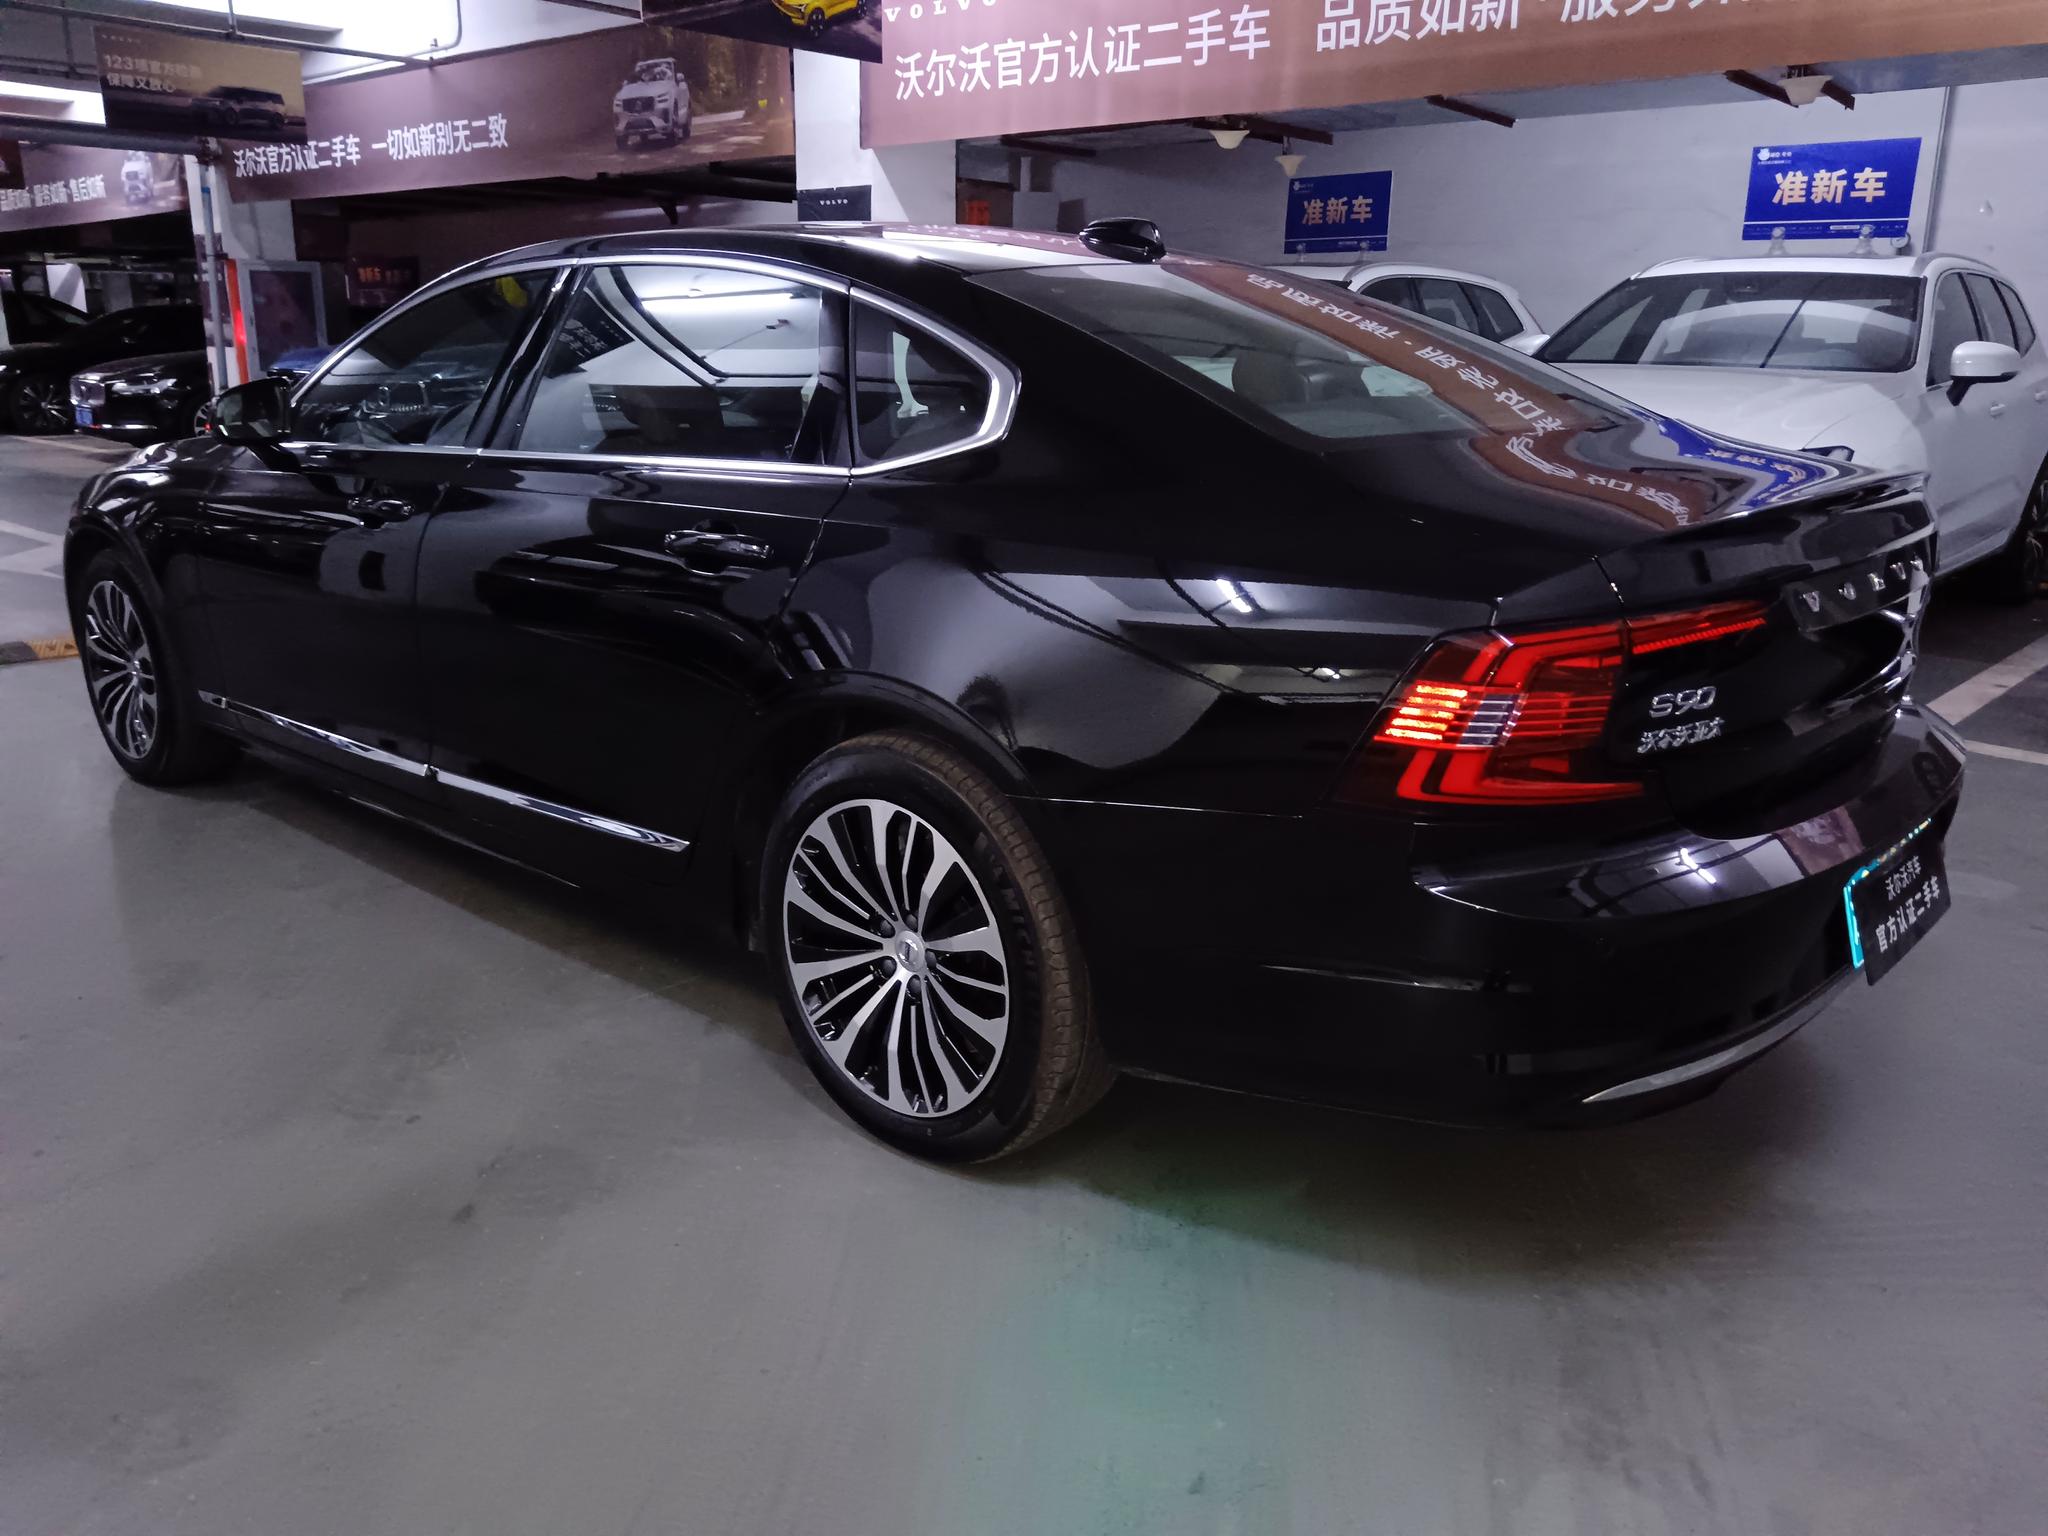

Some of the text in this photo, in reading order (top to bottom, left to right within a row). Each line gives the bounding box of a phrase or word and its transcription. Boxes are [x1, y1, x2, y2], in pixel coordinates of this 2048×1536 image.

[895, 4, 1270, 100] 沃尔沃官方认证二手车
[233, 113, 508, 178] 沃尔沃官方认证二手车 一切如新别无二致
[1771, 166, 1888, 206] 准新车
[1302, 195, 1373, 226] 准新车
[1649, 686, 1717, 718] S90
[1885, 856, 1921, 901] 沃尔沃汽车
[1876, 875, 1940, 953] 官方认证二手车
